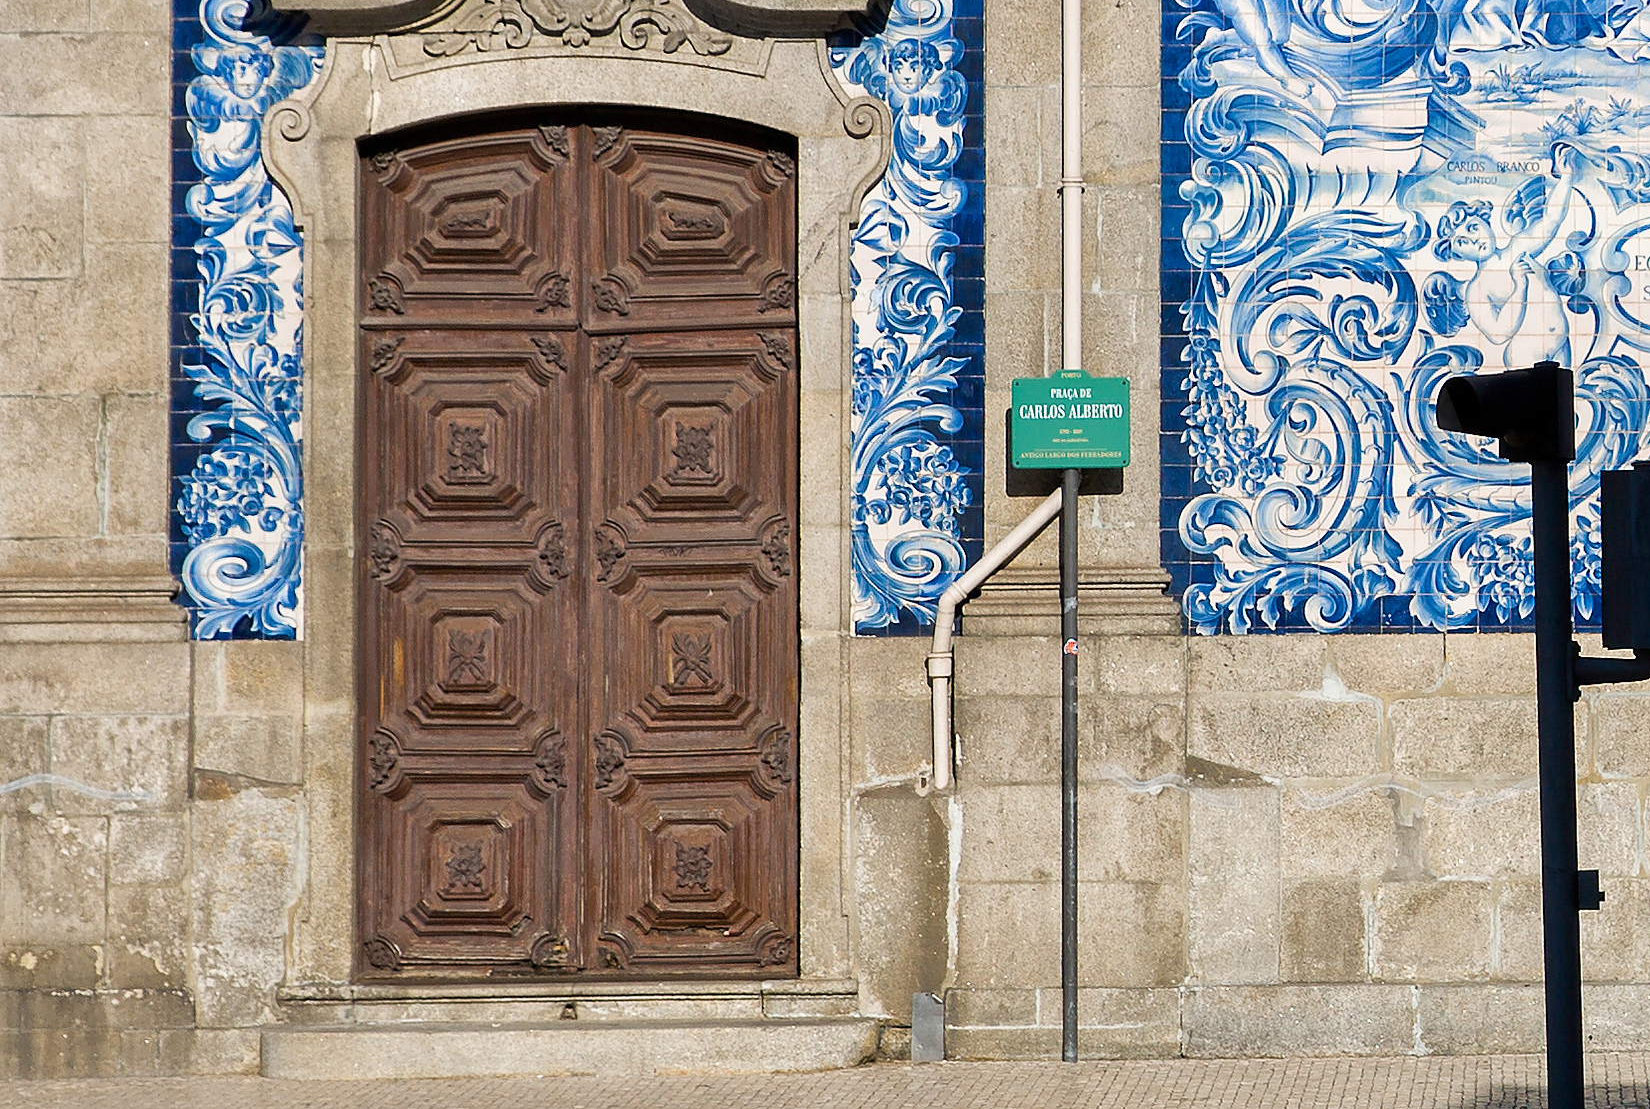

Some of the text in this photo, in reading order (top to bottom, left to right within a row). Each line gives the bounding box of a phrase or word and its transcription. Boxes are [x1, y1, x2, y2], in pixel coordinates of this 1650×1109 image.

[1446, 161, 1540, 173] CARLOS BRANCO
[1050, 388, 1092, 400] PRAÇA DE
[1019, 403, 1123, 419] CARLOS ALBERTO
